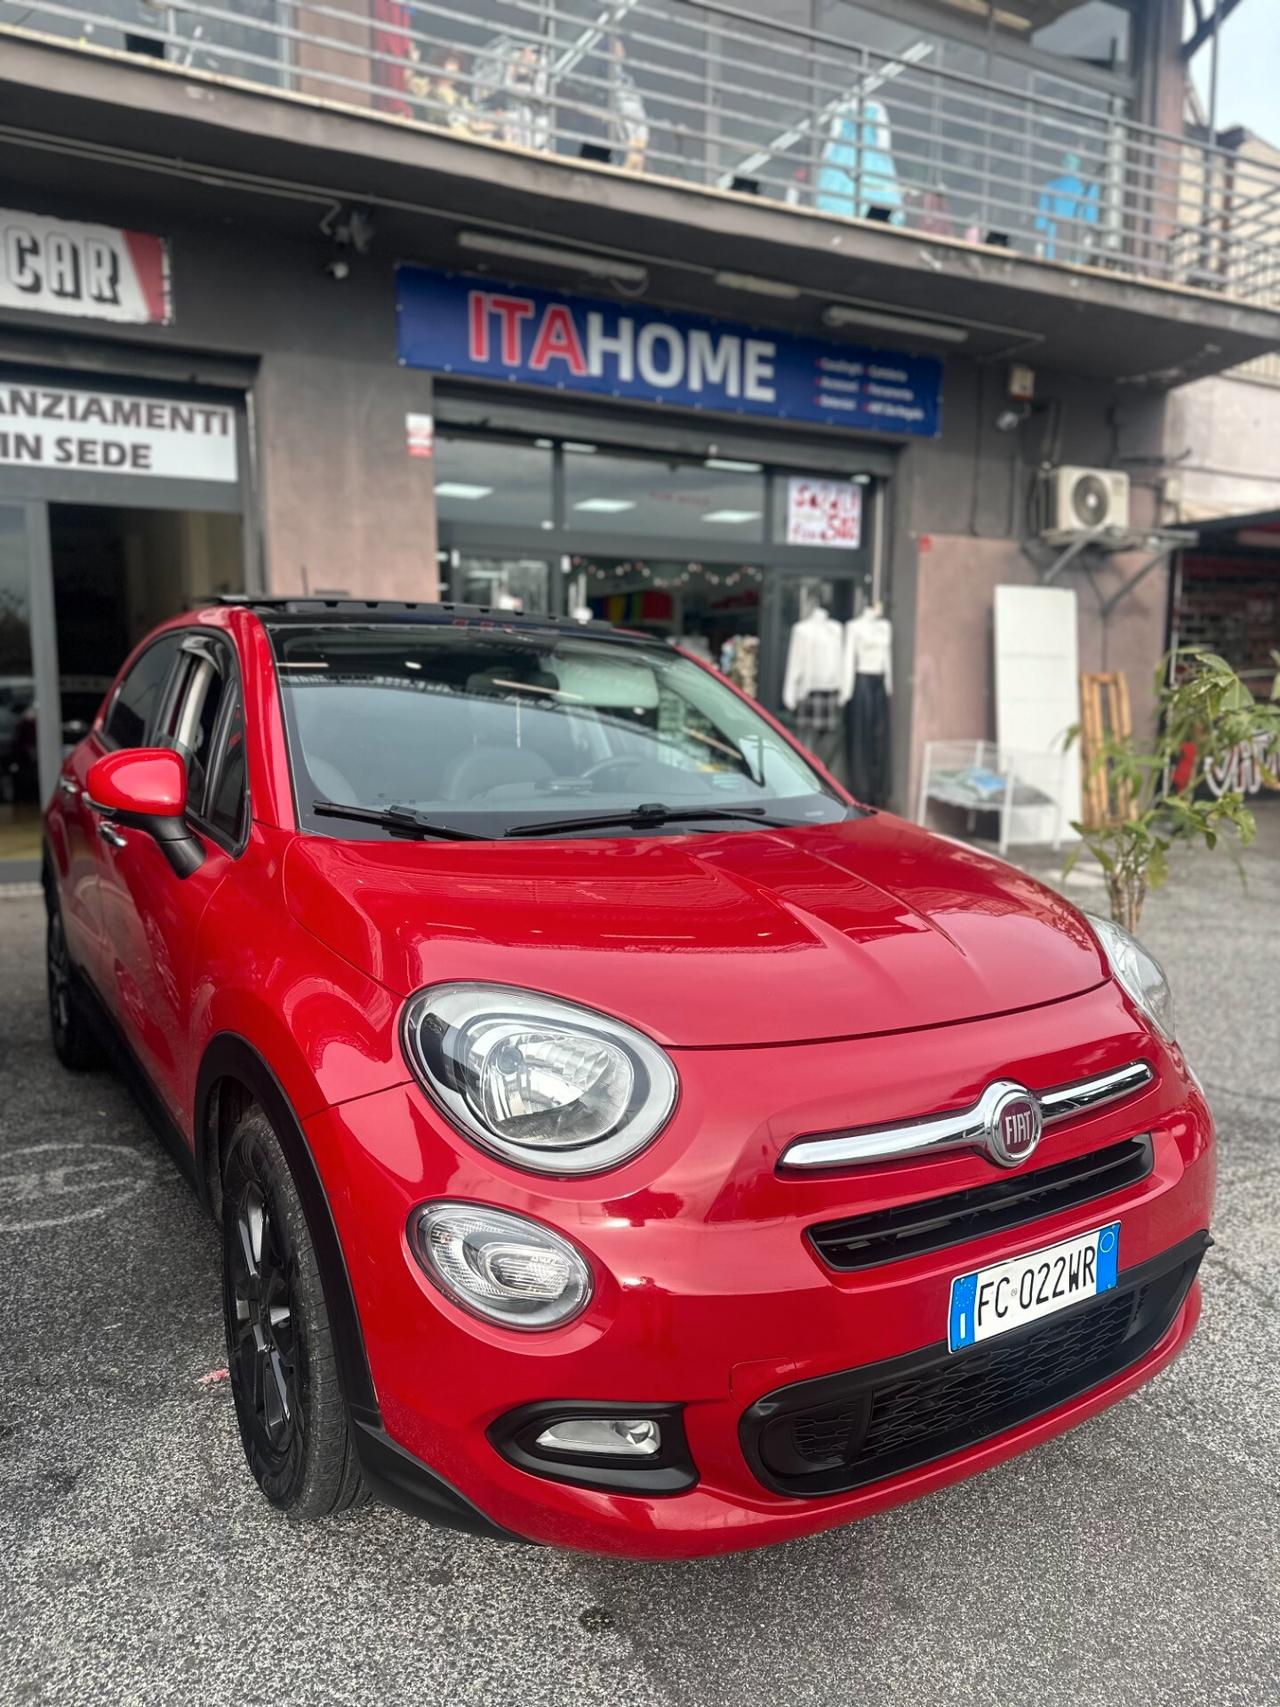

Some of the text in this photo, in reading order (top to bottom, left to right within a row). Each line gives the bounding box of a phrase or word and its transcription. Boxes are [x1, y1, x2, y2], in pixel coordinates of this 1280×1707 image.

[4, 224, 121, 306] CAR
[469, 291, 776, 402] ITAHOME
[0, 389, 229, 435] NZIAMENTI
[0, 433, 153, 469] IN SEDE
[1005, 1111, 1031, 1145] FIAT
[977, 1276, 1010, 1327] FC
[1019, 1245, 1095, 1310] 022WR
